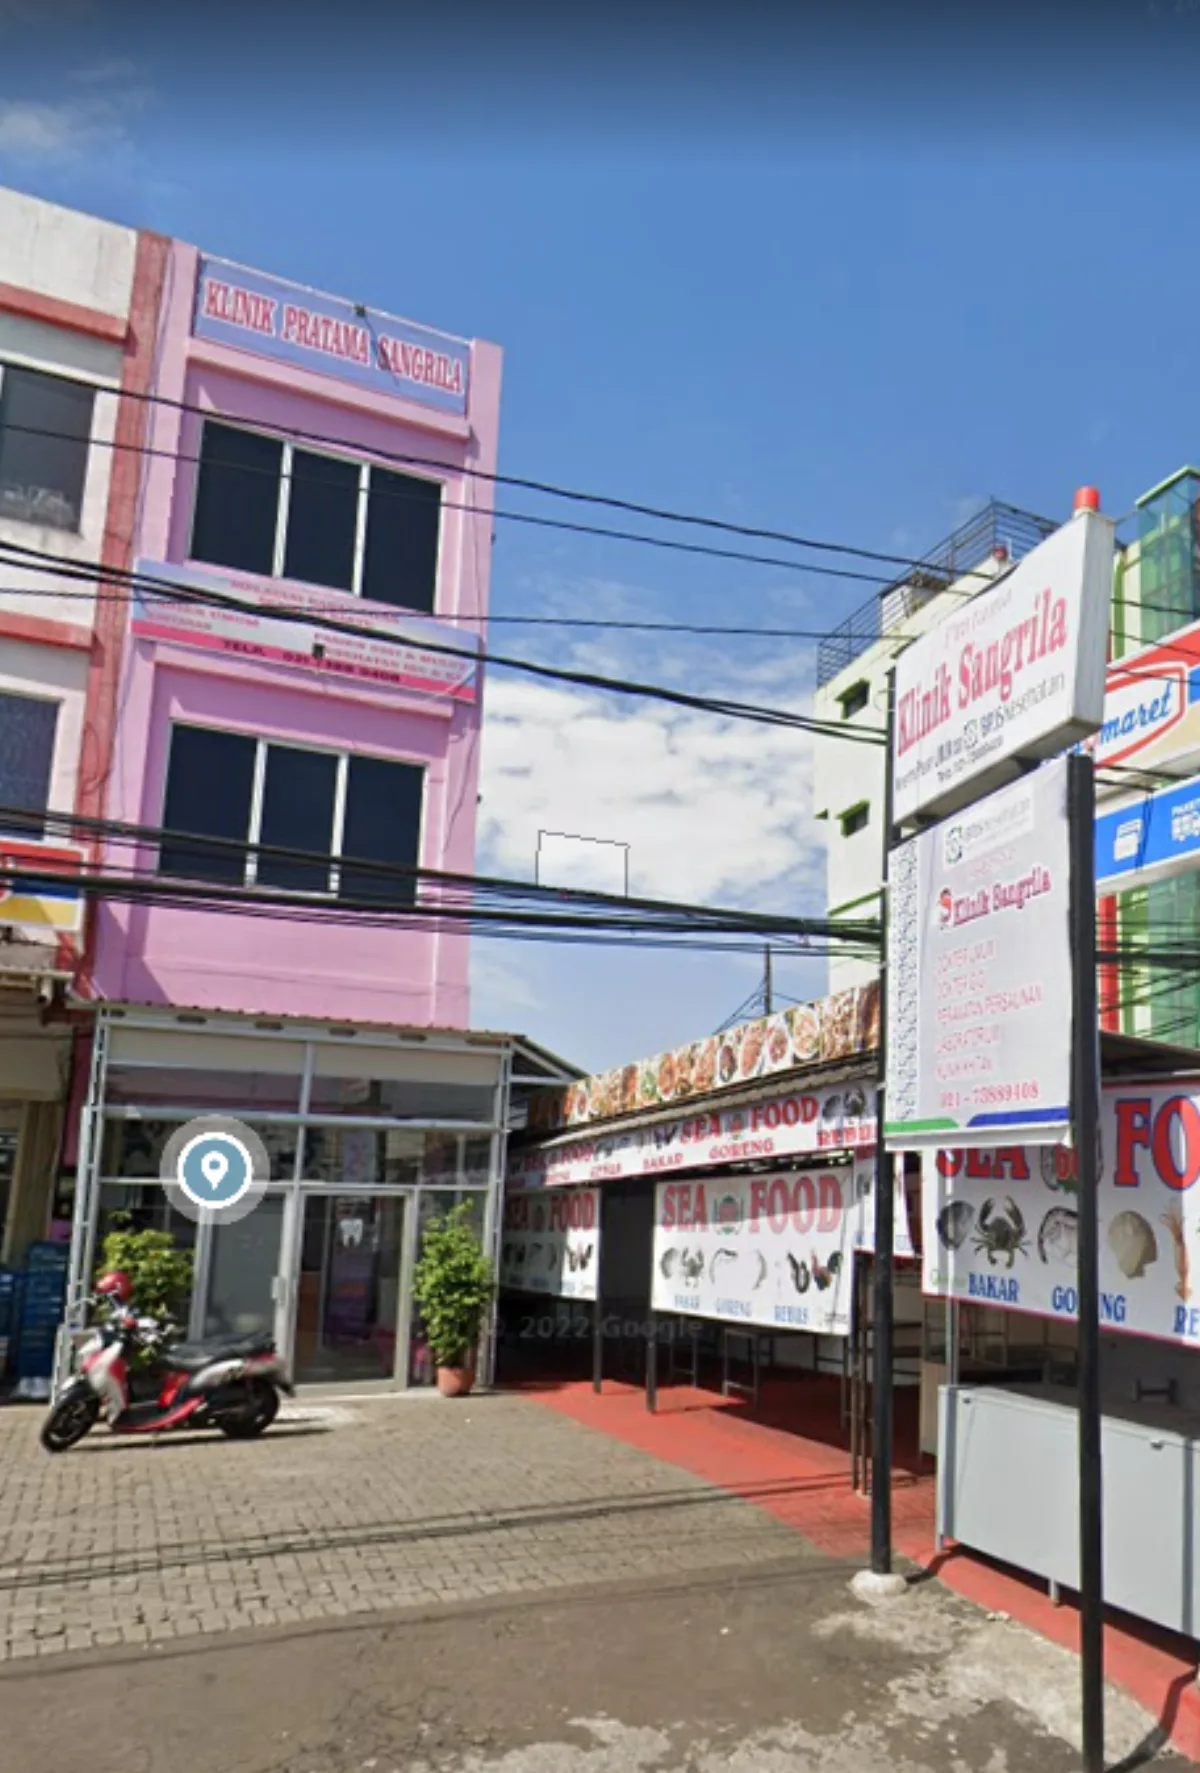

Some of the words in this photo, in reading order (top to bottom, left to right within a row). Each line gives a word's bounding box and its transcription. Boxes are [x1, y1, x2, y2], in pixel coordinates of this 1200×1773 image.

[205, 280, 276, 335] KLINIK
[283, 304, 370, 365] PRATAMA
[377, 335, 463, 394] SANGRILA
[898, 661, 952, 757] Klinik
[958, 587, 1068, 709] Sangrila
[954, 890, 989, 926] Klinik
[993, 866, 1051, 910] Sangrila
[680, 1112, 720, 1144] SEA
[750, 1096, 819, 1132] FOOD
[662, 1184, 709, 1232] SEA
[748, 1174, 843, 1234] FOOD
[968, 1272, 1019, 1303] BAKAR
[1052, 1286, 1126, 1322] GONG
